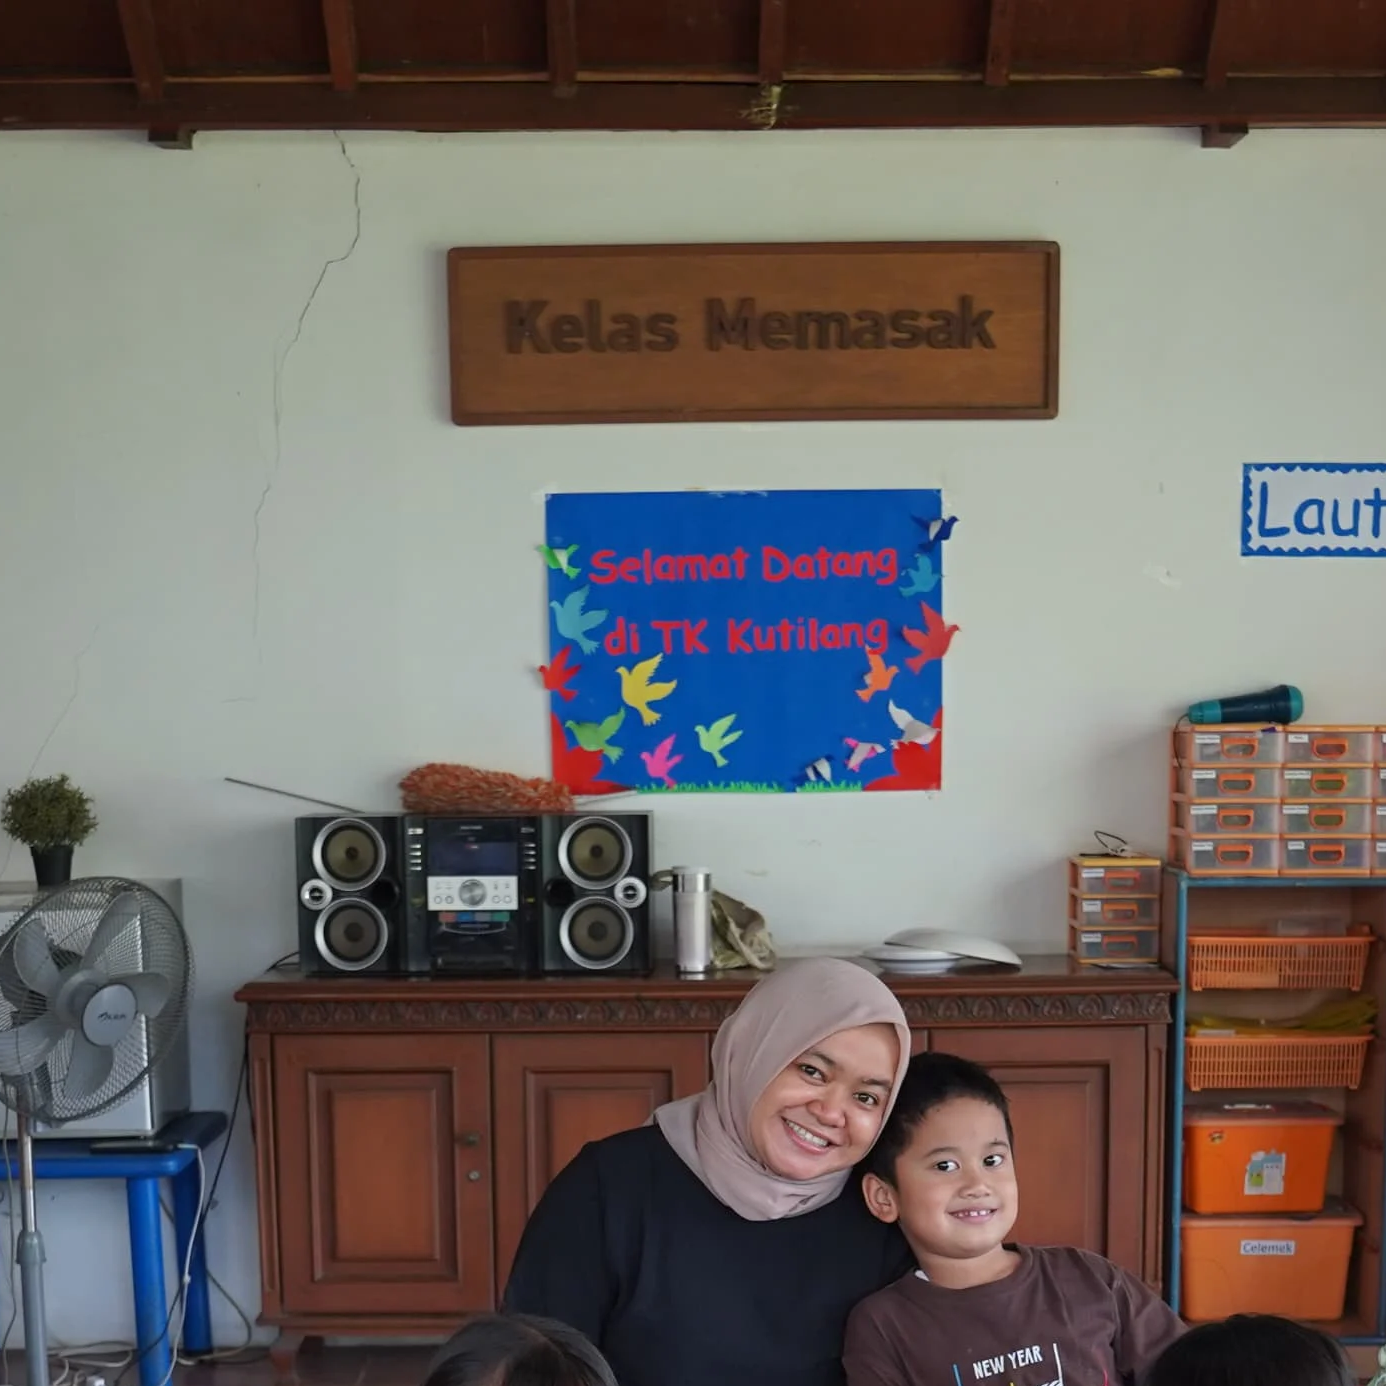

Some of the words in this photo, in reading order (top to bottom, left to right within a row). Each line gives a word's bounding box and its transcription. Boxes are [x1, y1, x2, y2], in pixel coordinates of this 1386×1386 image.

[504, 298, 679, 354] Kelas
[704, 295, 997, 353] Memasak
[589, 545, 751, 586] Selamat
[761, 546, 899, 585] Datang
[604, 617, 640, 656] di
[652, 618, 709, 655] TK
[726, 617, 889, 653] Kutilang
[1242, 1241, 1293, 1254] Celemek
[973, 1355, 1004, 1380] NEW
[1007, 1345, 1043, 1370] YEAR
